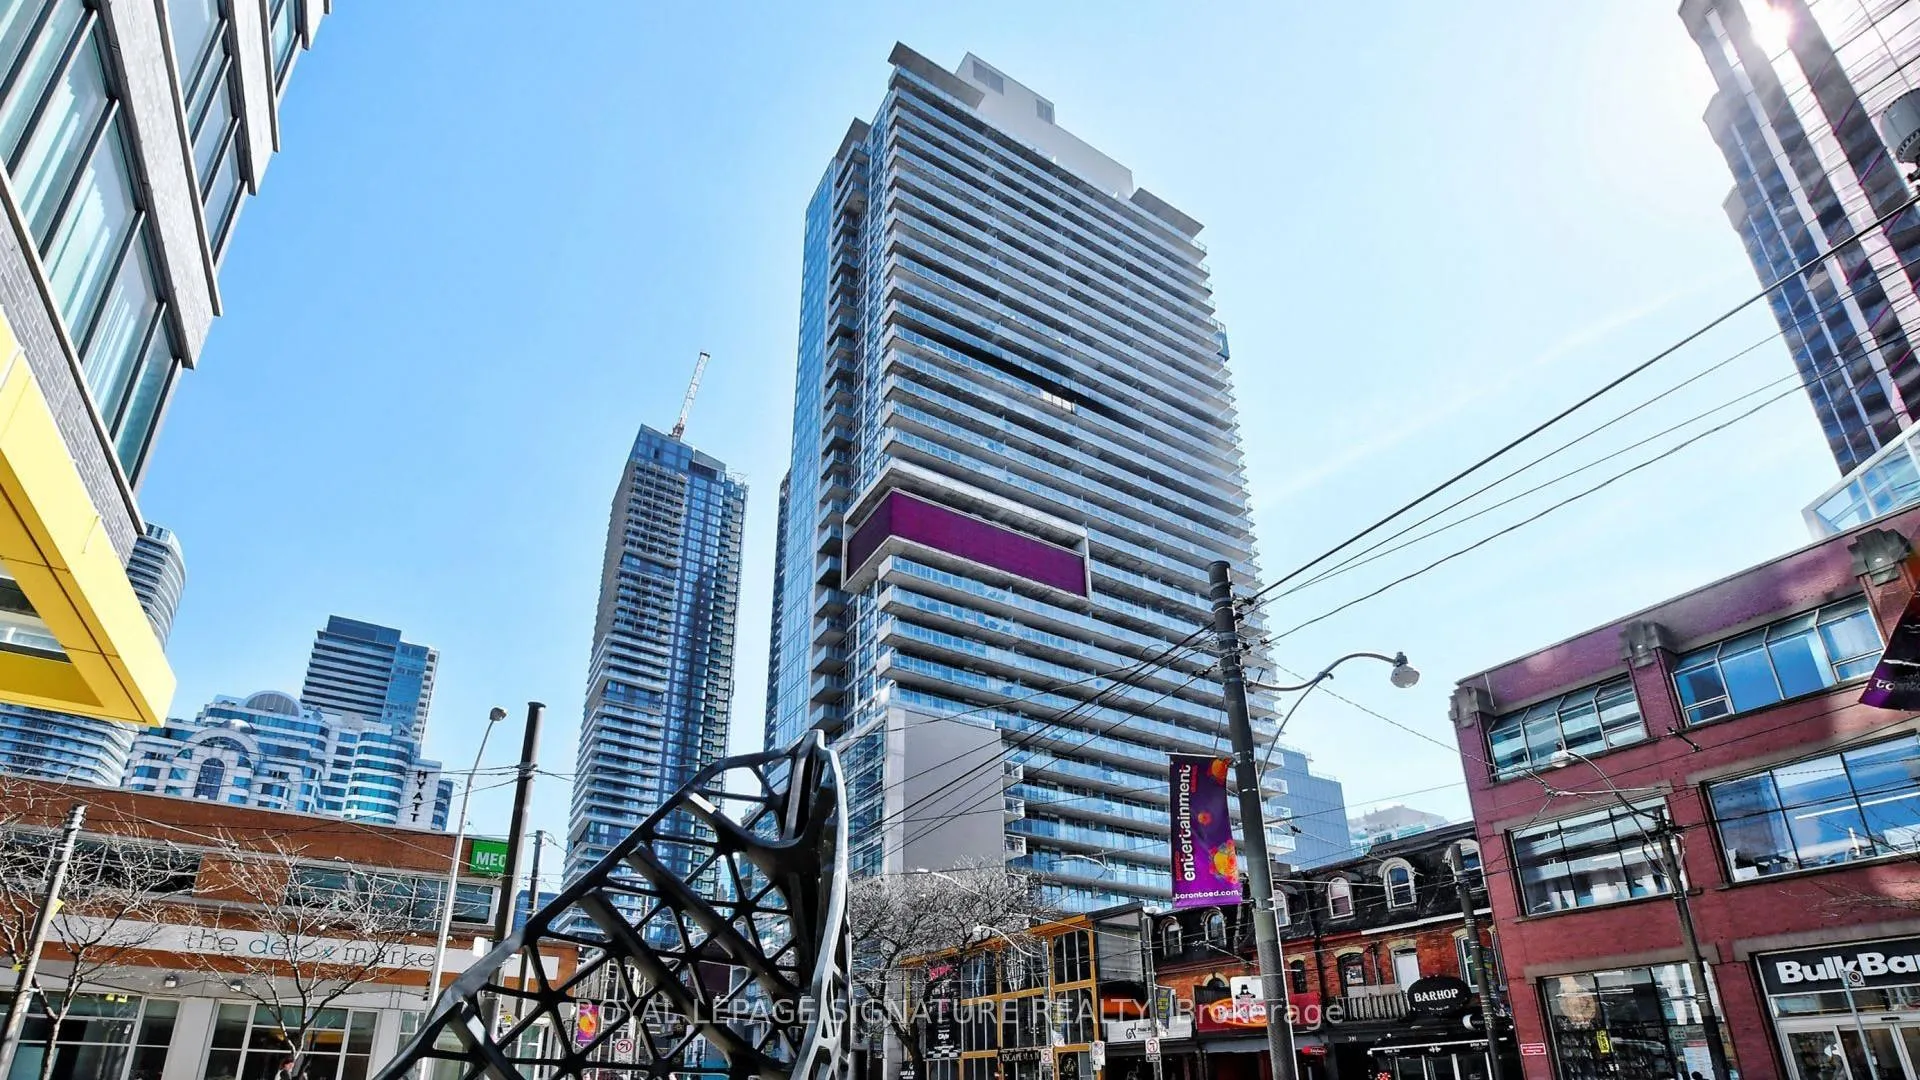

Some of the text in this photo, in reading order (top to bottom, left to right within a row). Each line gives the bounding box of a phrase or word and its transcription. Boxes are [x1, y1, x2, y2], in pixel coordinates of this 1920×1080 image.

[411, 770, 428, 822] HYATT
[1177, 764, 1196, 882] entertainment
[1175, 889, 1240, 900] torontoed.com
[186, 929, 238, 953] the
[343, 943, 435, 968] marke
[1414, 988, 1459, 1003] BARHOP
